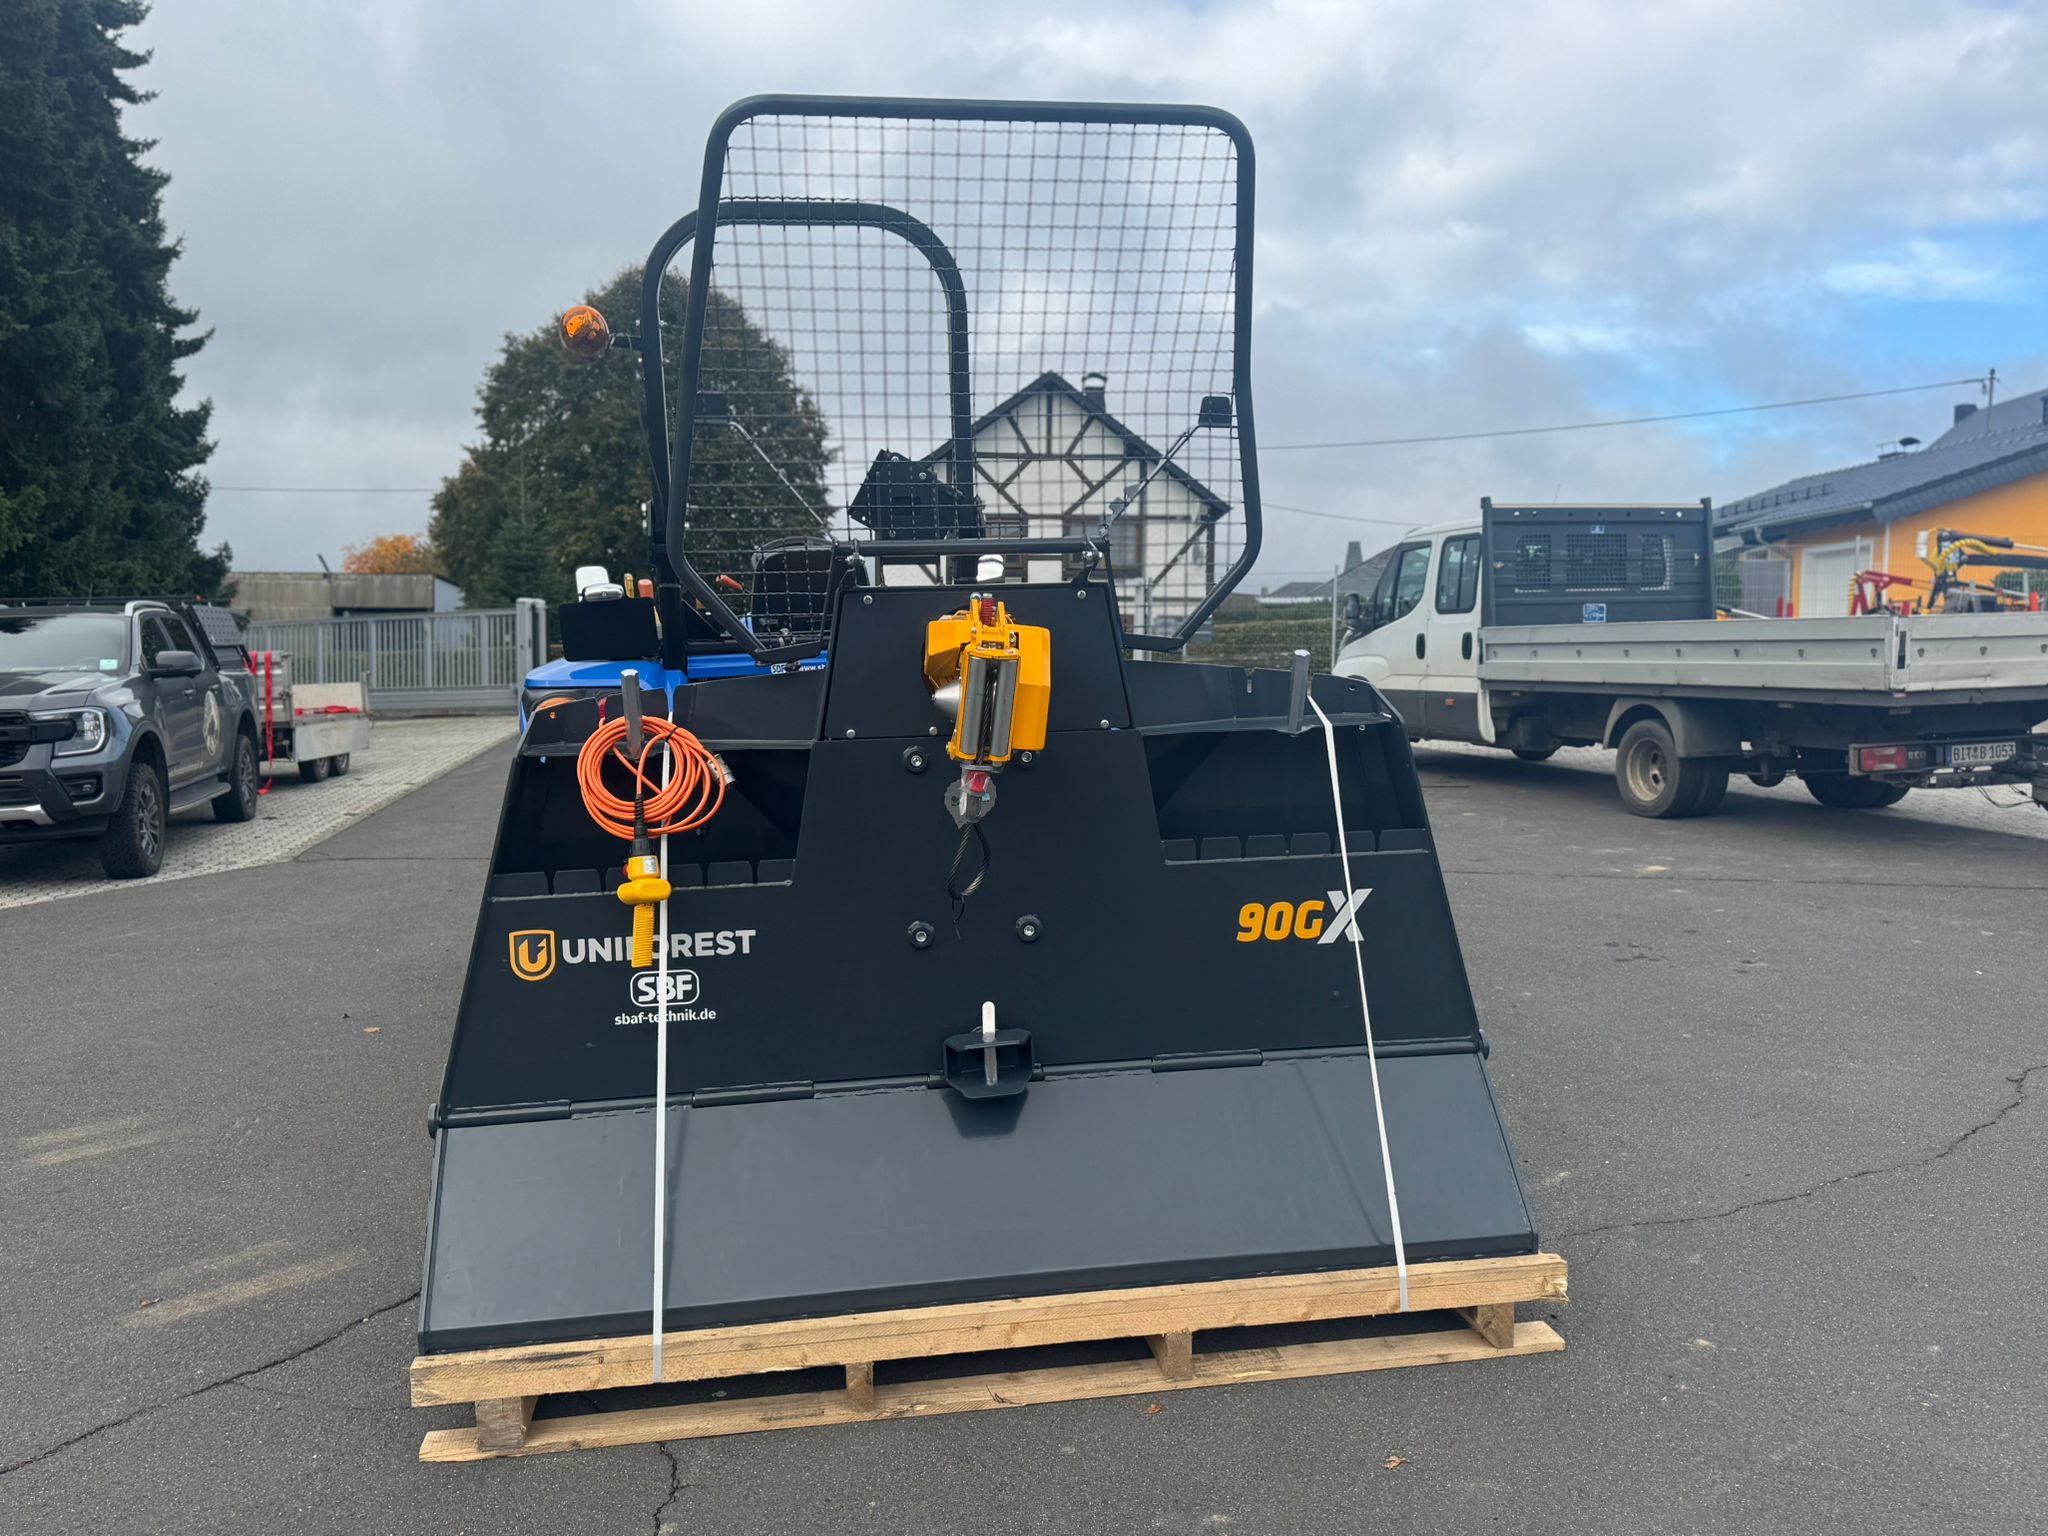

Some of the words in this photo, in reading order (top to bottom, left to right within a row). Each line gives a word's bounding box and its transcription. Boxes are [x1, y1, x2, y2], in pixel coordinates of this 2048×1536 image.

[1953, 747, 1971, 761] BIT
[1980, 745, 1987, 759] B
[1989, 743, 2015, 759] 1053
[1236, 888, 1373, 944] 90GX
[637, 974, 693, 1002] SBF
[614, 1008, 717, 1025] sbaf-tehnik.de
